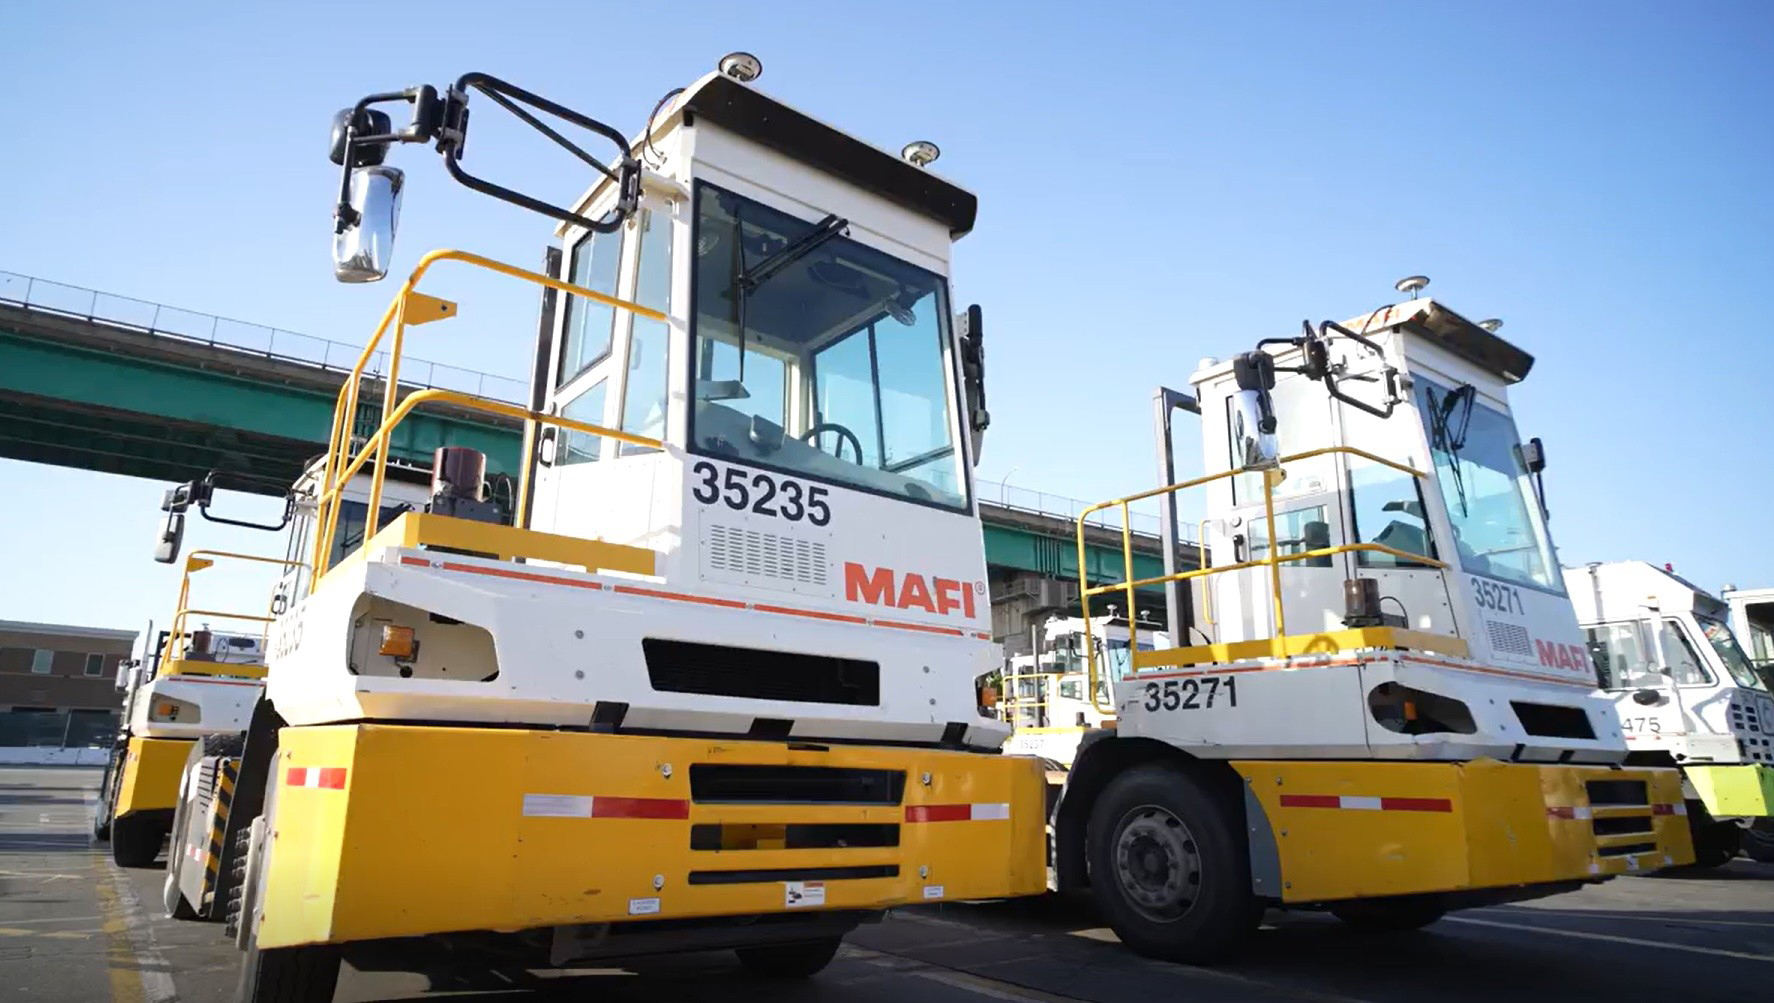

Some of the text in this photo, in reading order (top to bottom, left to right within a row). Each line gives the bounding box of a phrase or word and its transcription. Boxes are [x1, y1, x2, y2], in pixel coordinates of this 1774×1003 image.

[692, 461, 831, 527] 35235
[1471, 577, 1524, 615] 35271
[1535, 639, 1590, 674] MAFI
[1144, 675, 1237, 712] 35271
[1621, 717, 1661, 733] 475
